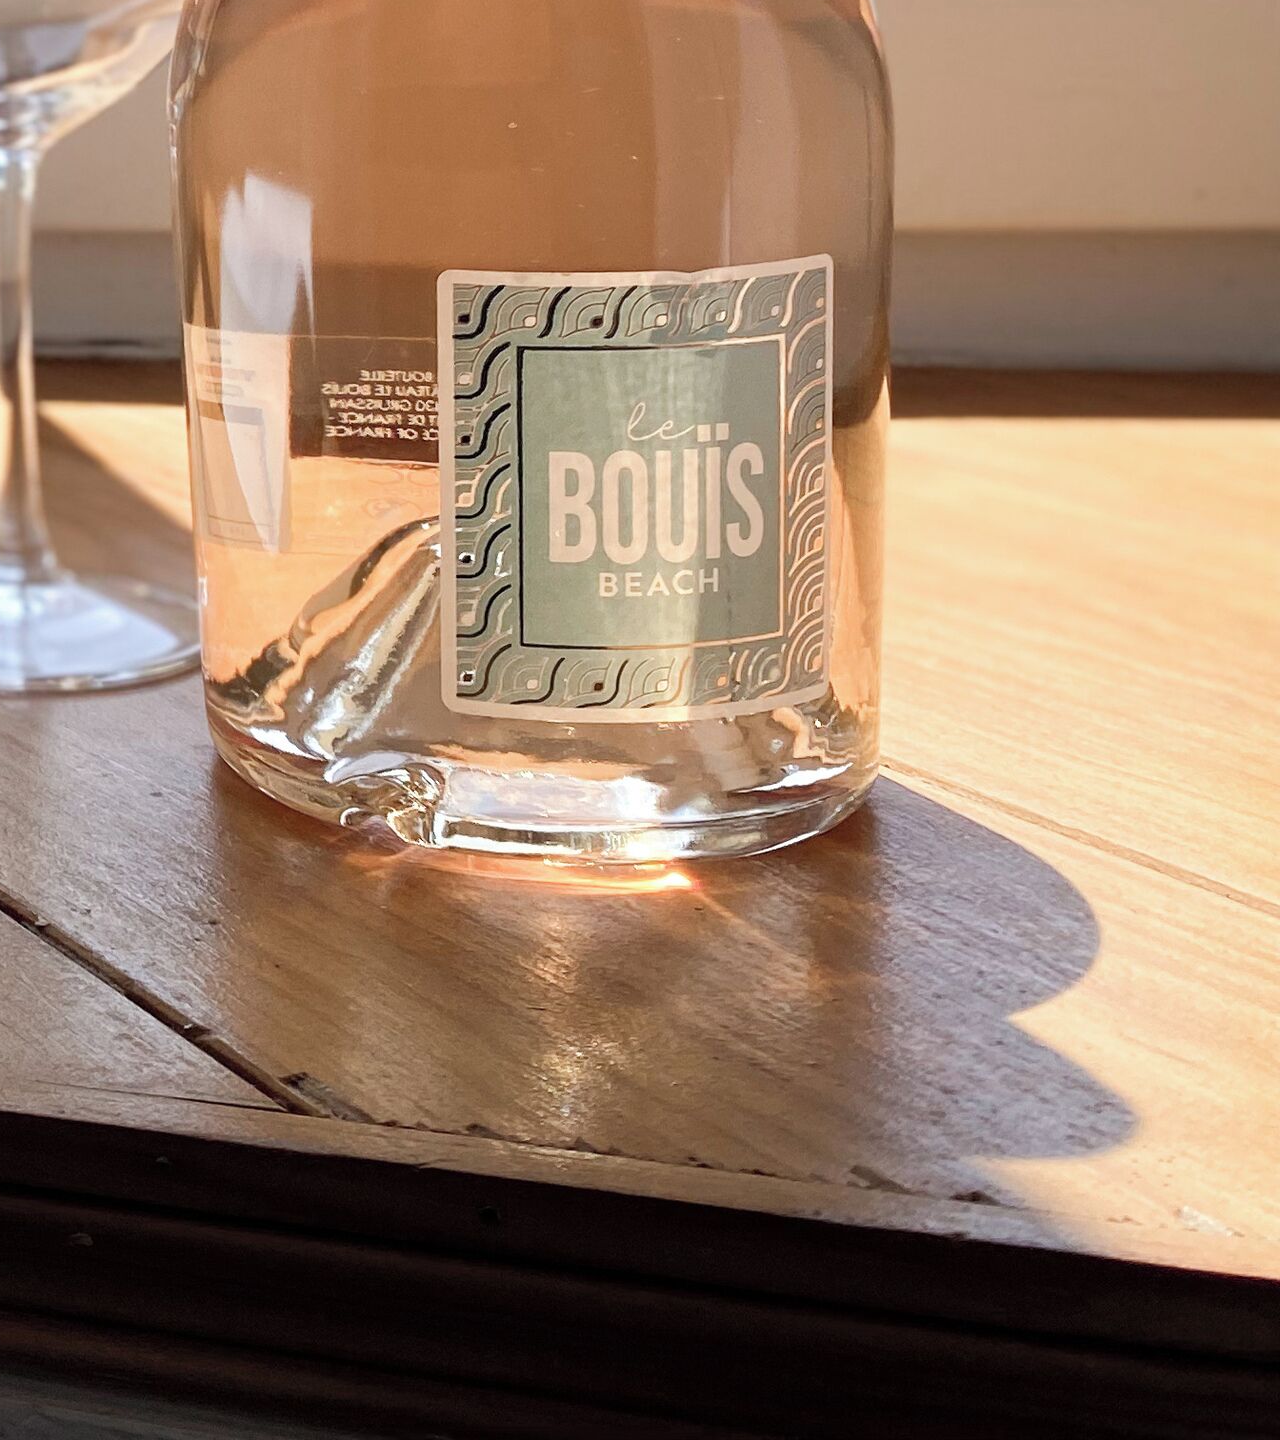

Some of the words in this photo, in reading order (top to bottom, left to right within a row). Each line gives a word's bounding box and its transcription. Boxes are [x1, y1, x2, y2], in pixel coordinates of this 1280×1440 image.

[627, 402, 695, 441] le
[549, 423, 764, 565] BOUÏS
[599, 568, 719, 598] BEACH
